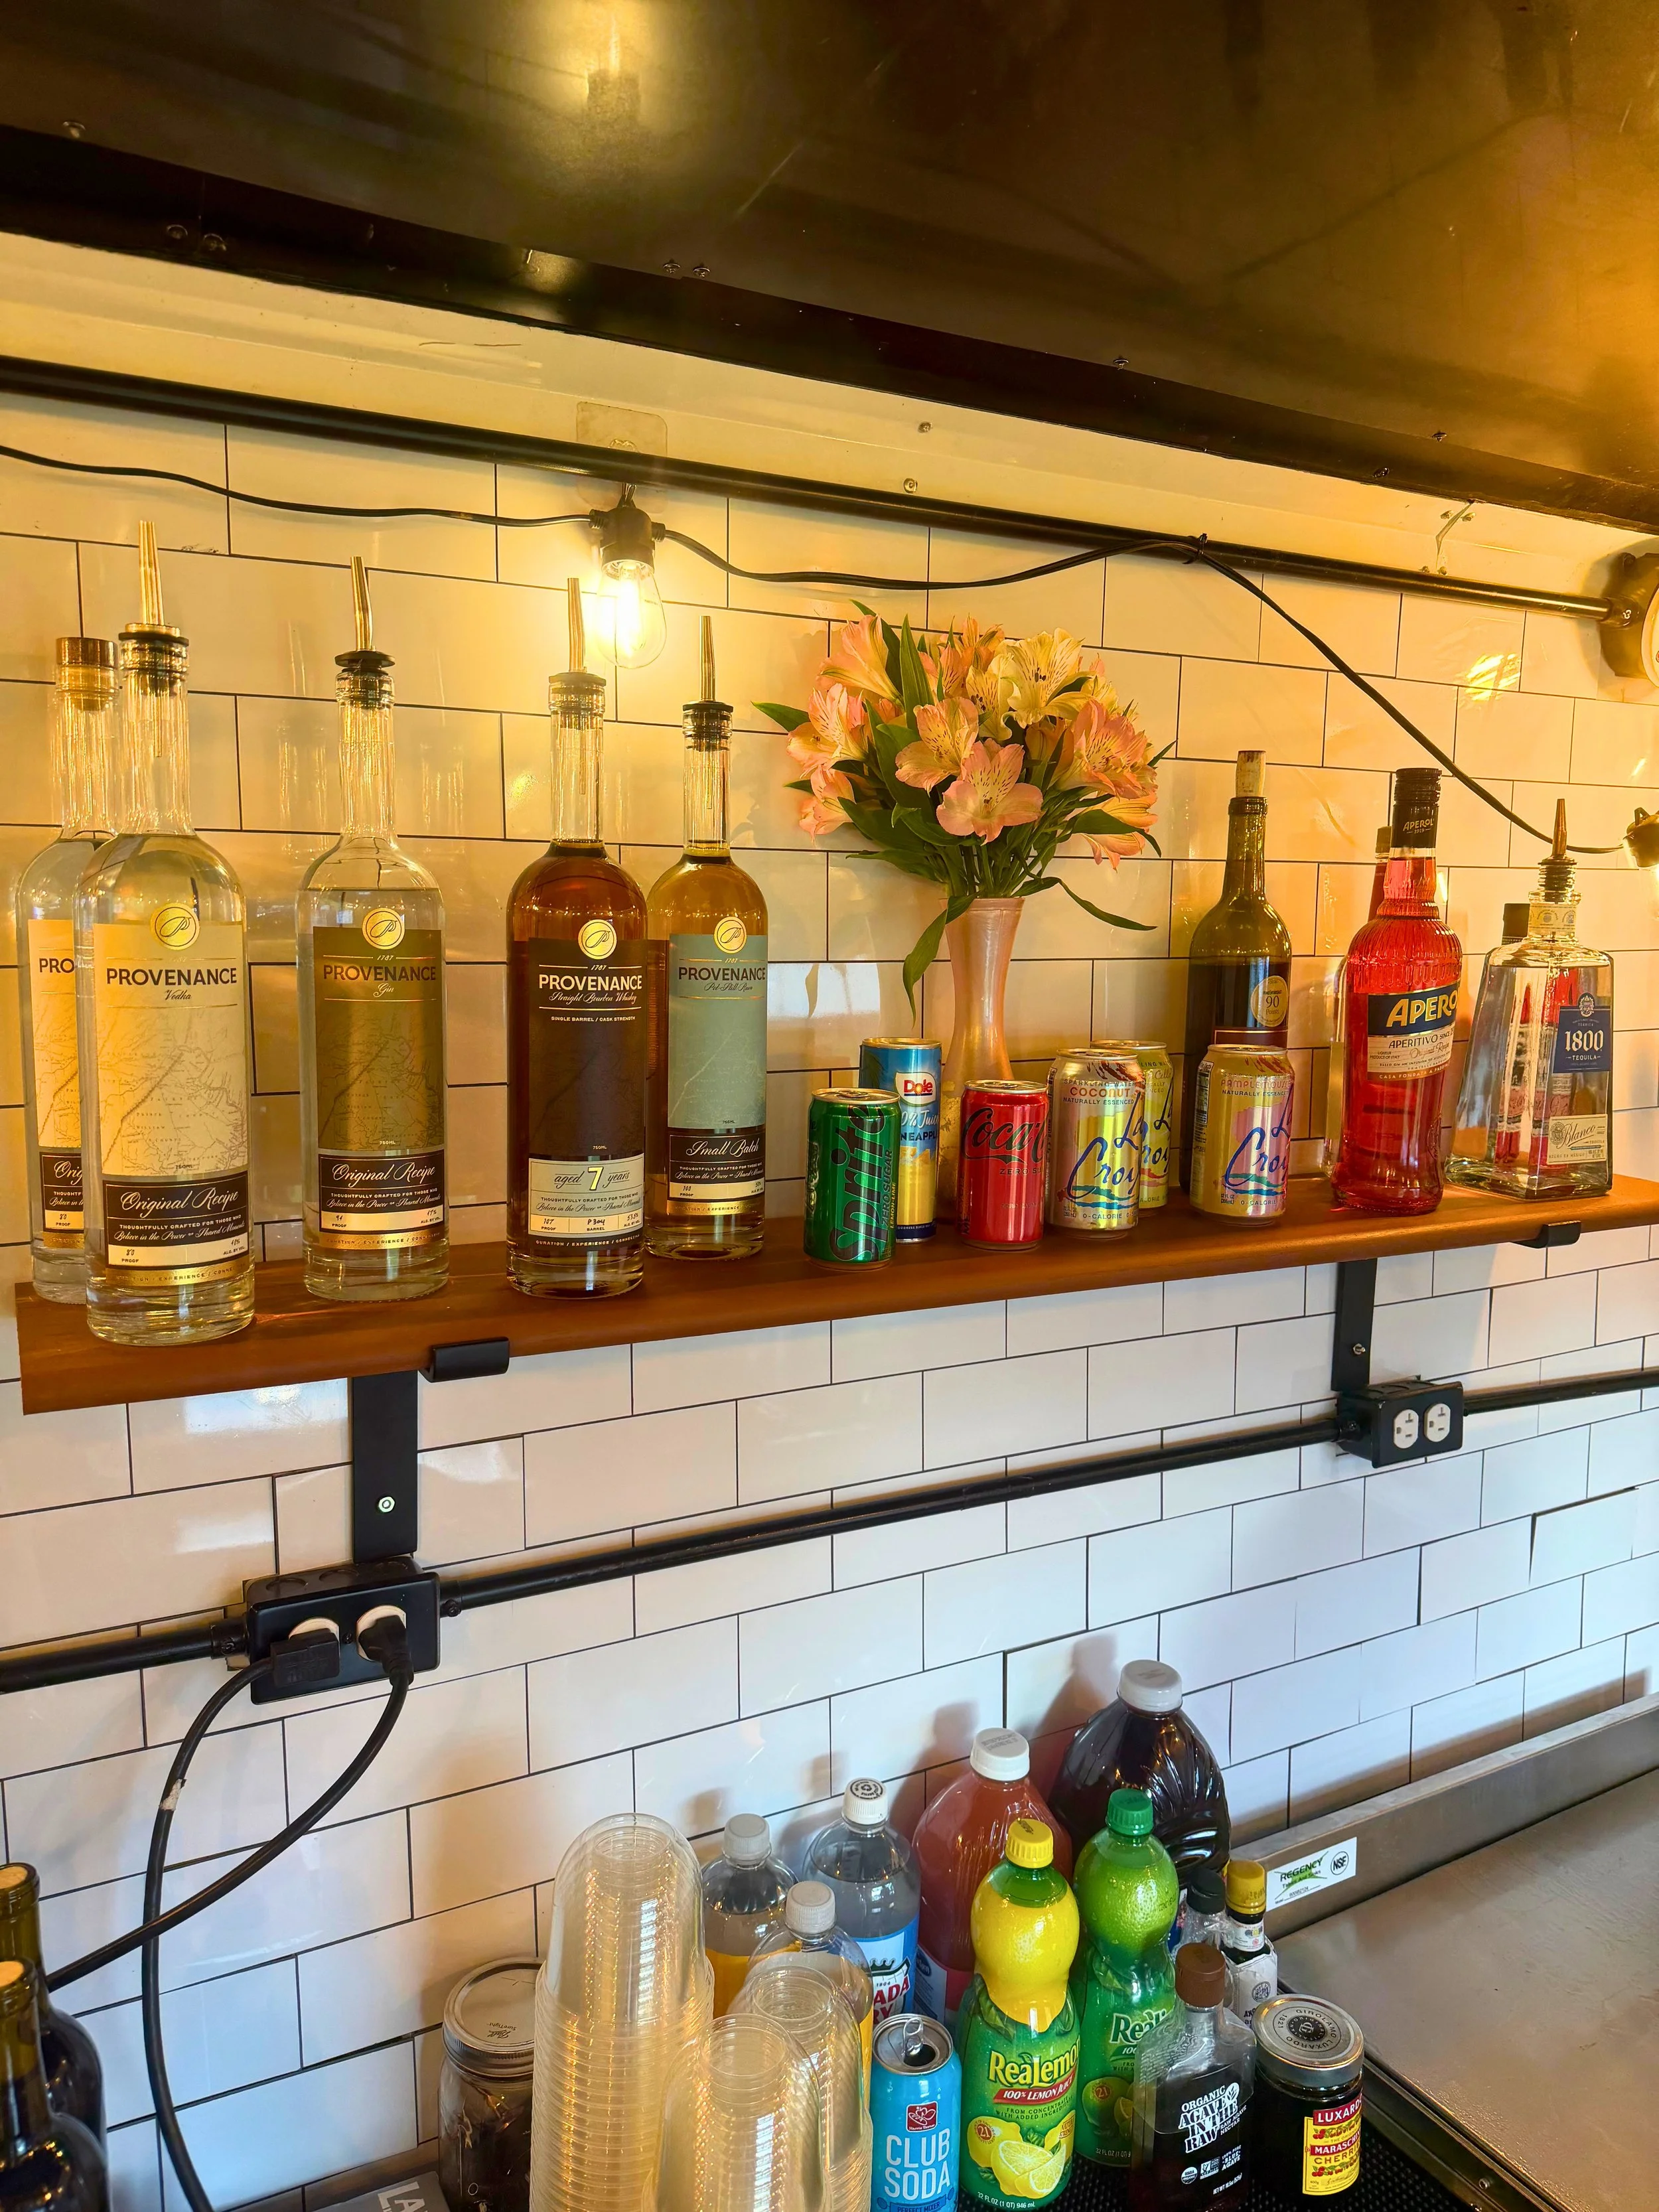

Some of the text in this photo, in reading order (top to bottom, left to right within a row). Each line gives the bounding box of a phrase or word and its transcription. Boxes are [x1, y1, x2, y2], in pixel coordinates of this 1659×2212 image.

[1403, 818, 1434, 831] APEROL
[107, 968, 237, 986] PROVENANCE
[323, 965, 436, 981] PROVENANCE
[679, 967, 766, 981] PROVENANCE
[373, 983, 394, 997] Gin
[539, 974, 642, 991] PROVENANCE
[165, 990, 192, 1001] Vodka
[549, 992, 636, 1005] Straight Bourbon Whiskey
[1265, 995, 1279, 1008] 90
[1389, 1035, 1437, 1049] APERITIVO
[1565, 1030, 1603, 1051] 1800
[904, 1079, 933, 1095] Dole
[1070, 1086, 1130, 1097] COCONUT
[902, 1112, 916, 1126] 0%
[901, 1131, 936, 1141] NEAPPL
[963, 1107, 1046, 1165] Coca-C
[1556, 1122, 1595, 1149] Blanco
[686, 1138, 760, 1157] Small Batch
[54, 1161, 82, 1185] Orig
[332, 1162, 435, 1187] Original Recipe
[554, 1167, 630, 1191] aged 7 years
[830, 1104, 887, 1262] Sprite
[881, 1149, 893, 1227] ZERO SUGAR
[50, 1197, 70, 1206] Believe
[121, 1187, 239, 1218] Original Recipe
[575, 1203, 595, 1212] Power
[603, 1203, 623, 1211] Shared
[114, 1231, 139, 1241] Believe
[161, 1231, 186, 1240] Power
[195, 1228, 221, 1238] Shared
[1280, 1858, 1323, 1882] REGENCY
[1333, 1856, 1346, 1870] NSF
[874, 1976, 909, 2006] ADA
[1278, 2014, 1287, 2028] 1821
[1003, 2090, 1026, 2099] 100%
[1027, 2085, 1056, 2100] LEMON
[1096, 2087, 1108, 2097] 21
[1181, 2085, 1225, 2112] ORGANIC
[1029, 2096, 1068, 2114] CONCENTRATE
[1041, 2095, 1073, 2118] INGREDIENTS
[1178, 2095, 1228, 2129] AGAVE
[1189, 2099, 1238, 2138] IN THE
[1220, 2105, 1246, 2130] RAW AGAVE
[977, 2125, 990, 2137] 21
[1220, 2118, 1240, 2136] NECTAR
[887, 2128, 950, 2168] CLUB
[1185, 2127, 1218, 2154] RAW
[1314, 2141, 1359, 2164] CHERRIE
[1222, 2155, 1240, 2171] AGAVE
[885, 2160, 950, 2201] SODA
[924, 2201, 940, 2212] MIXER
